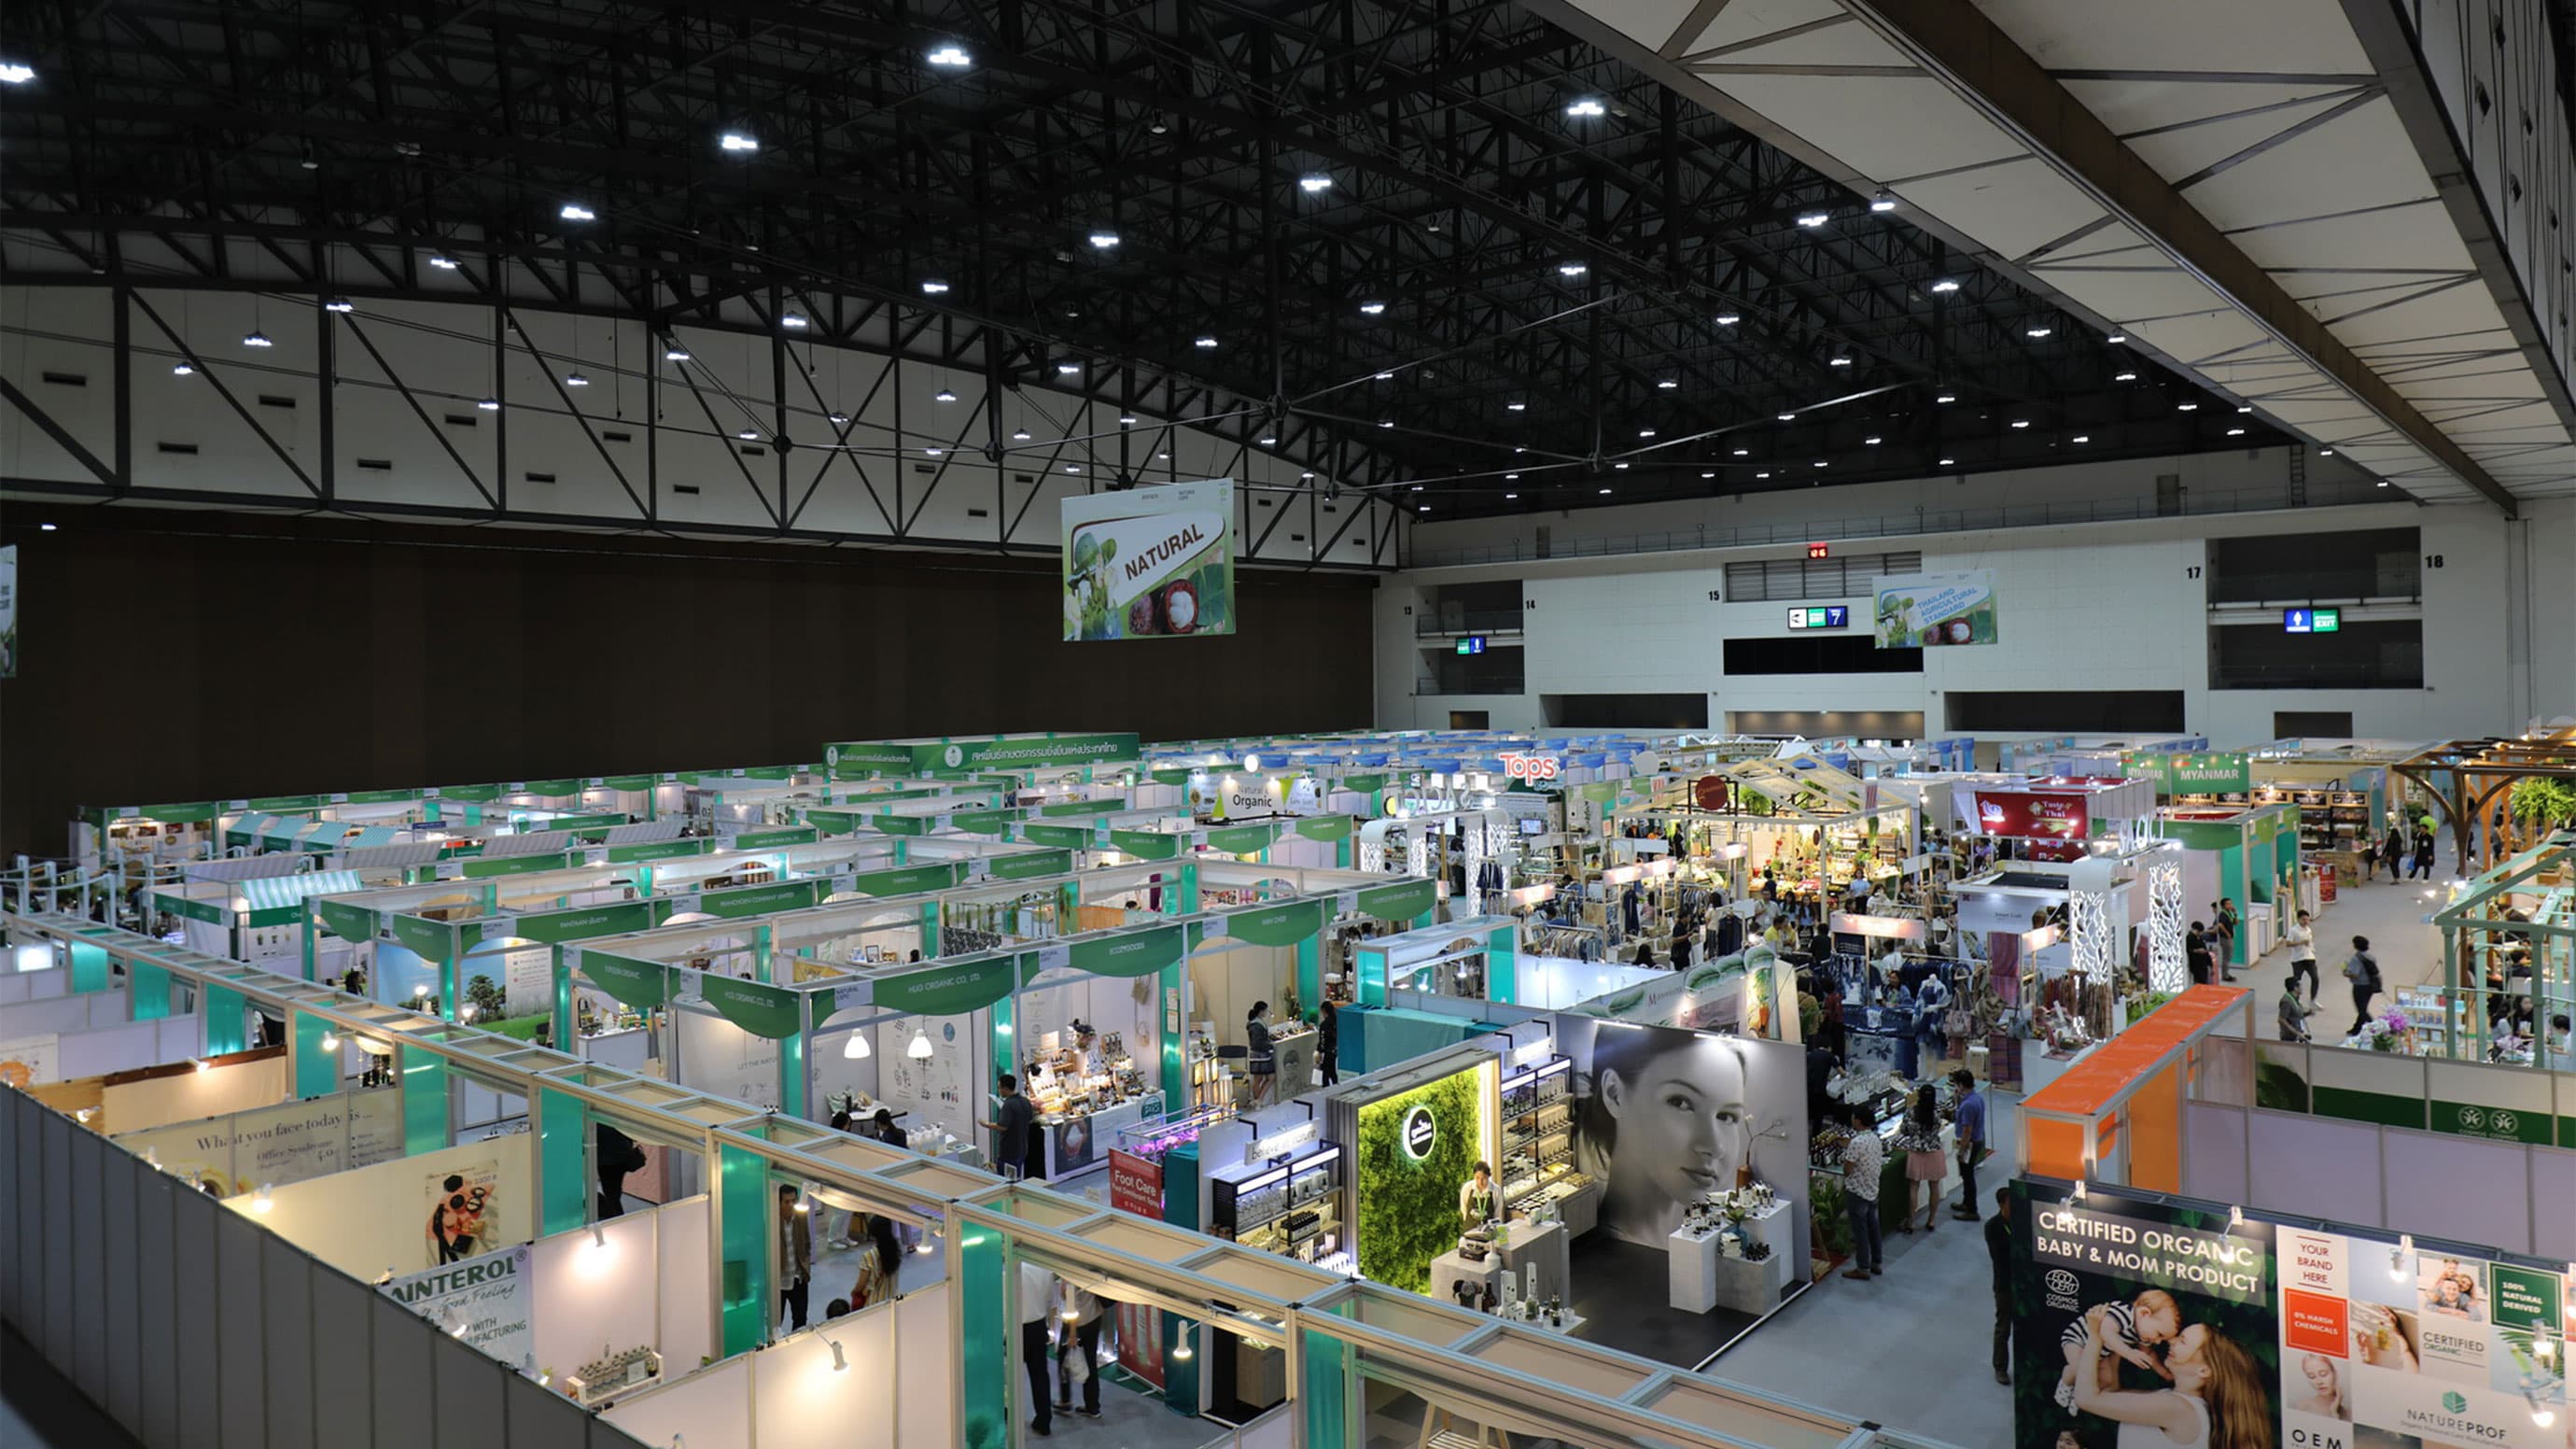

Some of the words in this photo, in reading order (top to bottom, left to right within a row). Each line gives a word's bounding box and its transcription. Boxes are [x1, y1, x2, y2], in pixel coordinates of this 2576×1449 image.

[1124, 524, 1205, 581] NATURAL
[2425, 555, 2443, 569] 18
[2186, 566, 2201, 579] 17
[1708, 590, 1720, 601] 15
[1916, 587, 1955, 609] THAILAND
[1920, 587, 1978, 618] AGRICULTURAL
[1525, 599, 1536, 610] 14
[1830, 611, 1841, 626] 7
[1923, 601, 1966, 625] STANDARD
[2315, 619, 2336, 628] EXIT
[1499, 754, 1557, 786] Tops
[2126, 767, 2165, 781] MYANMAR
[2180, 768, 2240, 781] MYANMAR
[1232, 794, 1272, 810] Organic
[924, 977, 955, 991] ORGANIC
[197, 1134, 243, 1151] What
[245, 1129, 272, 1147] you
[275, 1121, 303, 1136] face
[305, 1112, 343, 1130] today
[348, 1108, 360, 1121] is
[1114, 1169, 1135, 1188] Foot
[1135, 1178, 1156, 1197] Care
[2038, 1211, 2136, 1245] CERTIFIED
[2143, 1231, 2254, 1267] ORGANIC
[2300, 1243, 2330, 1257] YOUR
[2037, 1236, 2083, 1259] BABY
[2089, 1247, 2102, 1263] &
[2107, 1249, 2160, 1273] MOM
[2164, 1260, 2259, 1293] PRODUCT
[2297, 1256, 2333, 1272] BRAND
[2303, 1271, 2328, 1285] HERE
[2502, 1281, 2527, 1292] 100%
[2502, 1291, 2543, 1304] NATURAL
[2502, 1301, 2541, 1314] DERIVED
[472, 1316, 497, 1332] WITH
[2307, 1314, 2333, 1325] HARSH
[2294, 1320, 2338, 1335] CHEMICALS
[2423, 1331, 2485, 1353] CERTIFIED
[2423, 1343, 2462, 1357] ORGANIC
[2406, 1409, 2508, 1441] NATUREPROF
